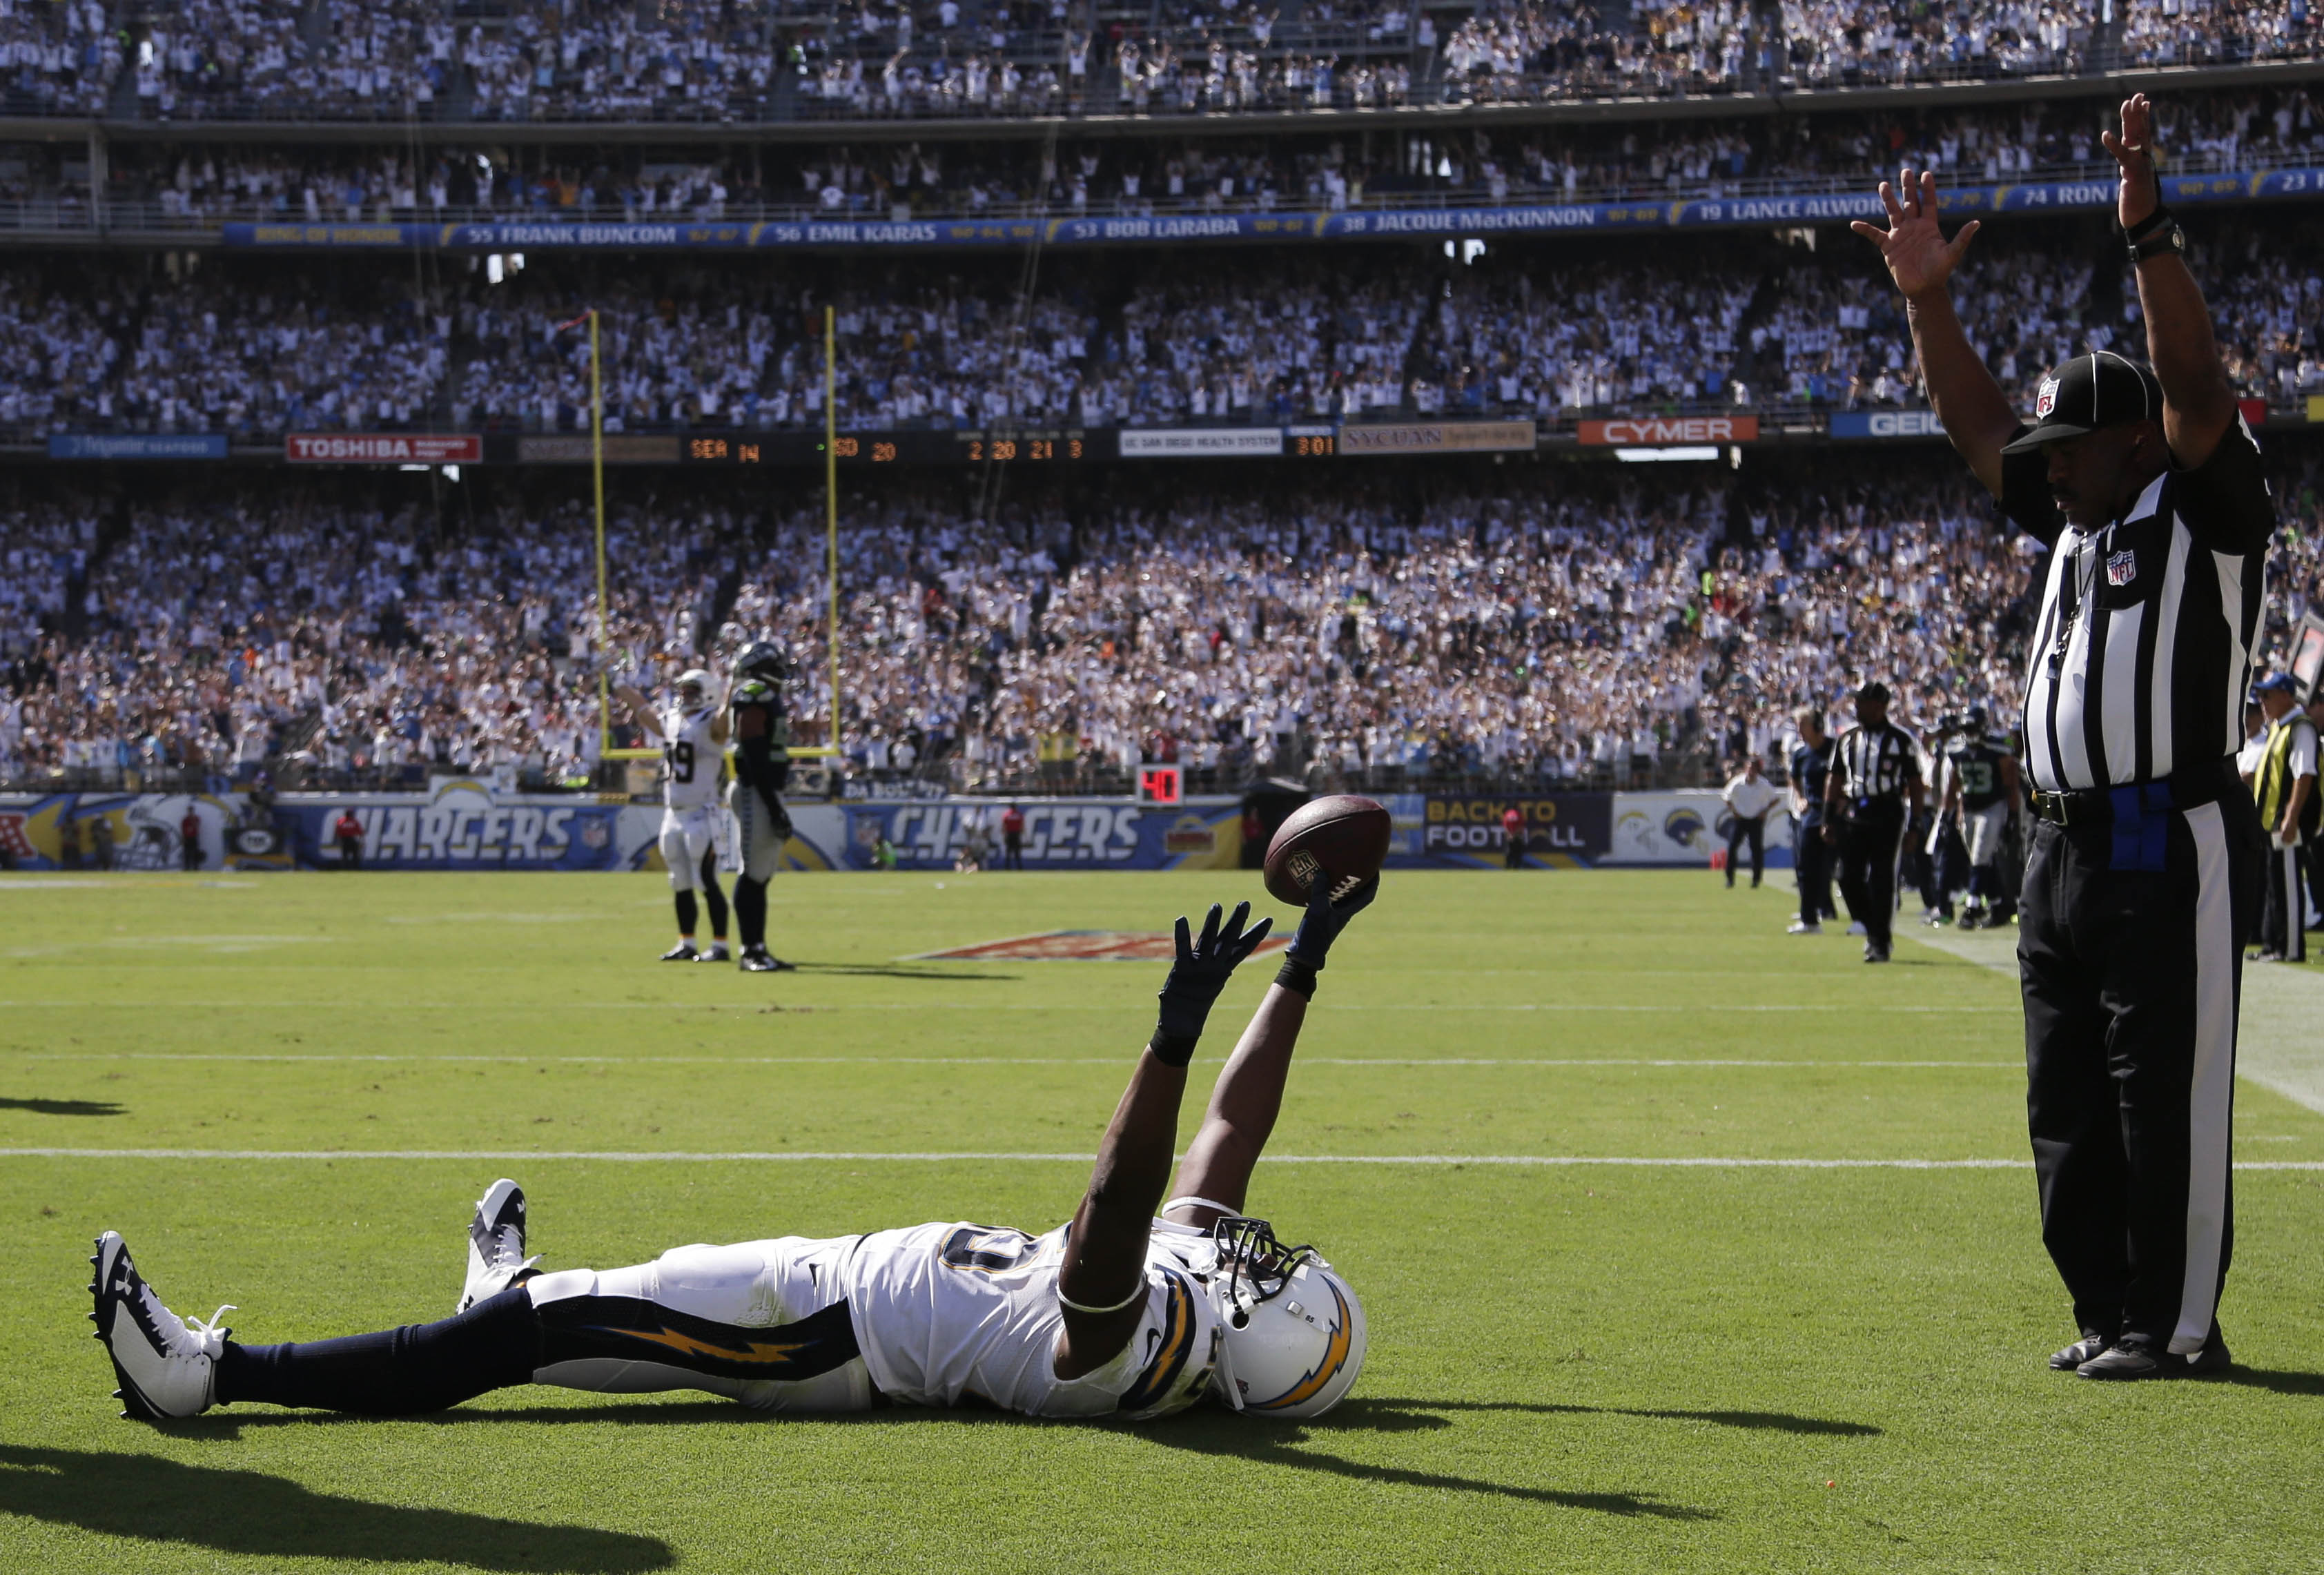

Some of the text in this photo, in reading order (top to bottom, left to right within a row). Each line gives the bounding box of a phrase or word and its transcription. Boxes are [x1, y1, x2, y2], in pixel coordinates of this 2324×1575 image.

[2282, 174, 2307, 192] 23
[2024, 189, 2048, 205] 74
[2058, 186, 2108, 204] RON
[1699, 197, 1887, 221] 19 LANCE ALWOR
[1106, 219, 1150, 237] BOB
[1153, 217, 1240, 237] LARABA
[1374, 213, 1454, 232] JACQUE
[1459, 208, 1595, 229] MacKINNON
[500, 226, 575, 243] FRANK
[578, 226, 676, 244] BUNCOM
[808, 226, 860, 242] EMIL
[863, 225, 936, 242] KARAS
[1603, 419, 1732, 443] CYMER
[1869, 412, 1947, 436] GEIC
[295, 438, 410, 458] TOSHIBA
[691, 438, 728, 459] SEA
[1348, 429, 1442, 447] SYCUAN
[2112, 562, 2133, 583] NFL
[1141, 768, 1179, 803] 40
[1427, 801, 1557, 822] BACK TO
[1426, 825, 1585, 847] FOOTLL
[1305, 1314, 1315, 1324] 85
